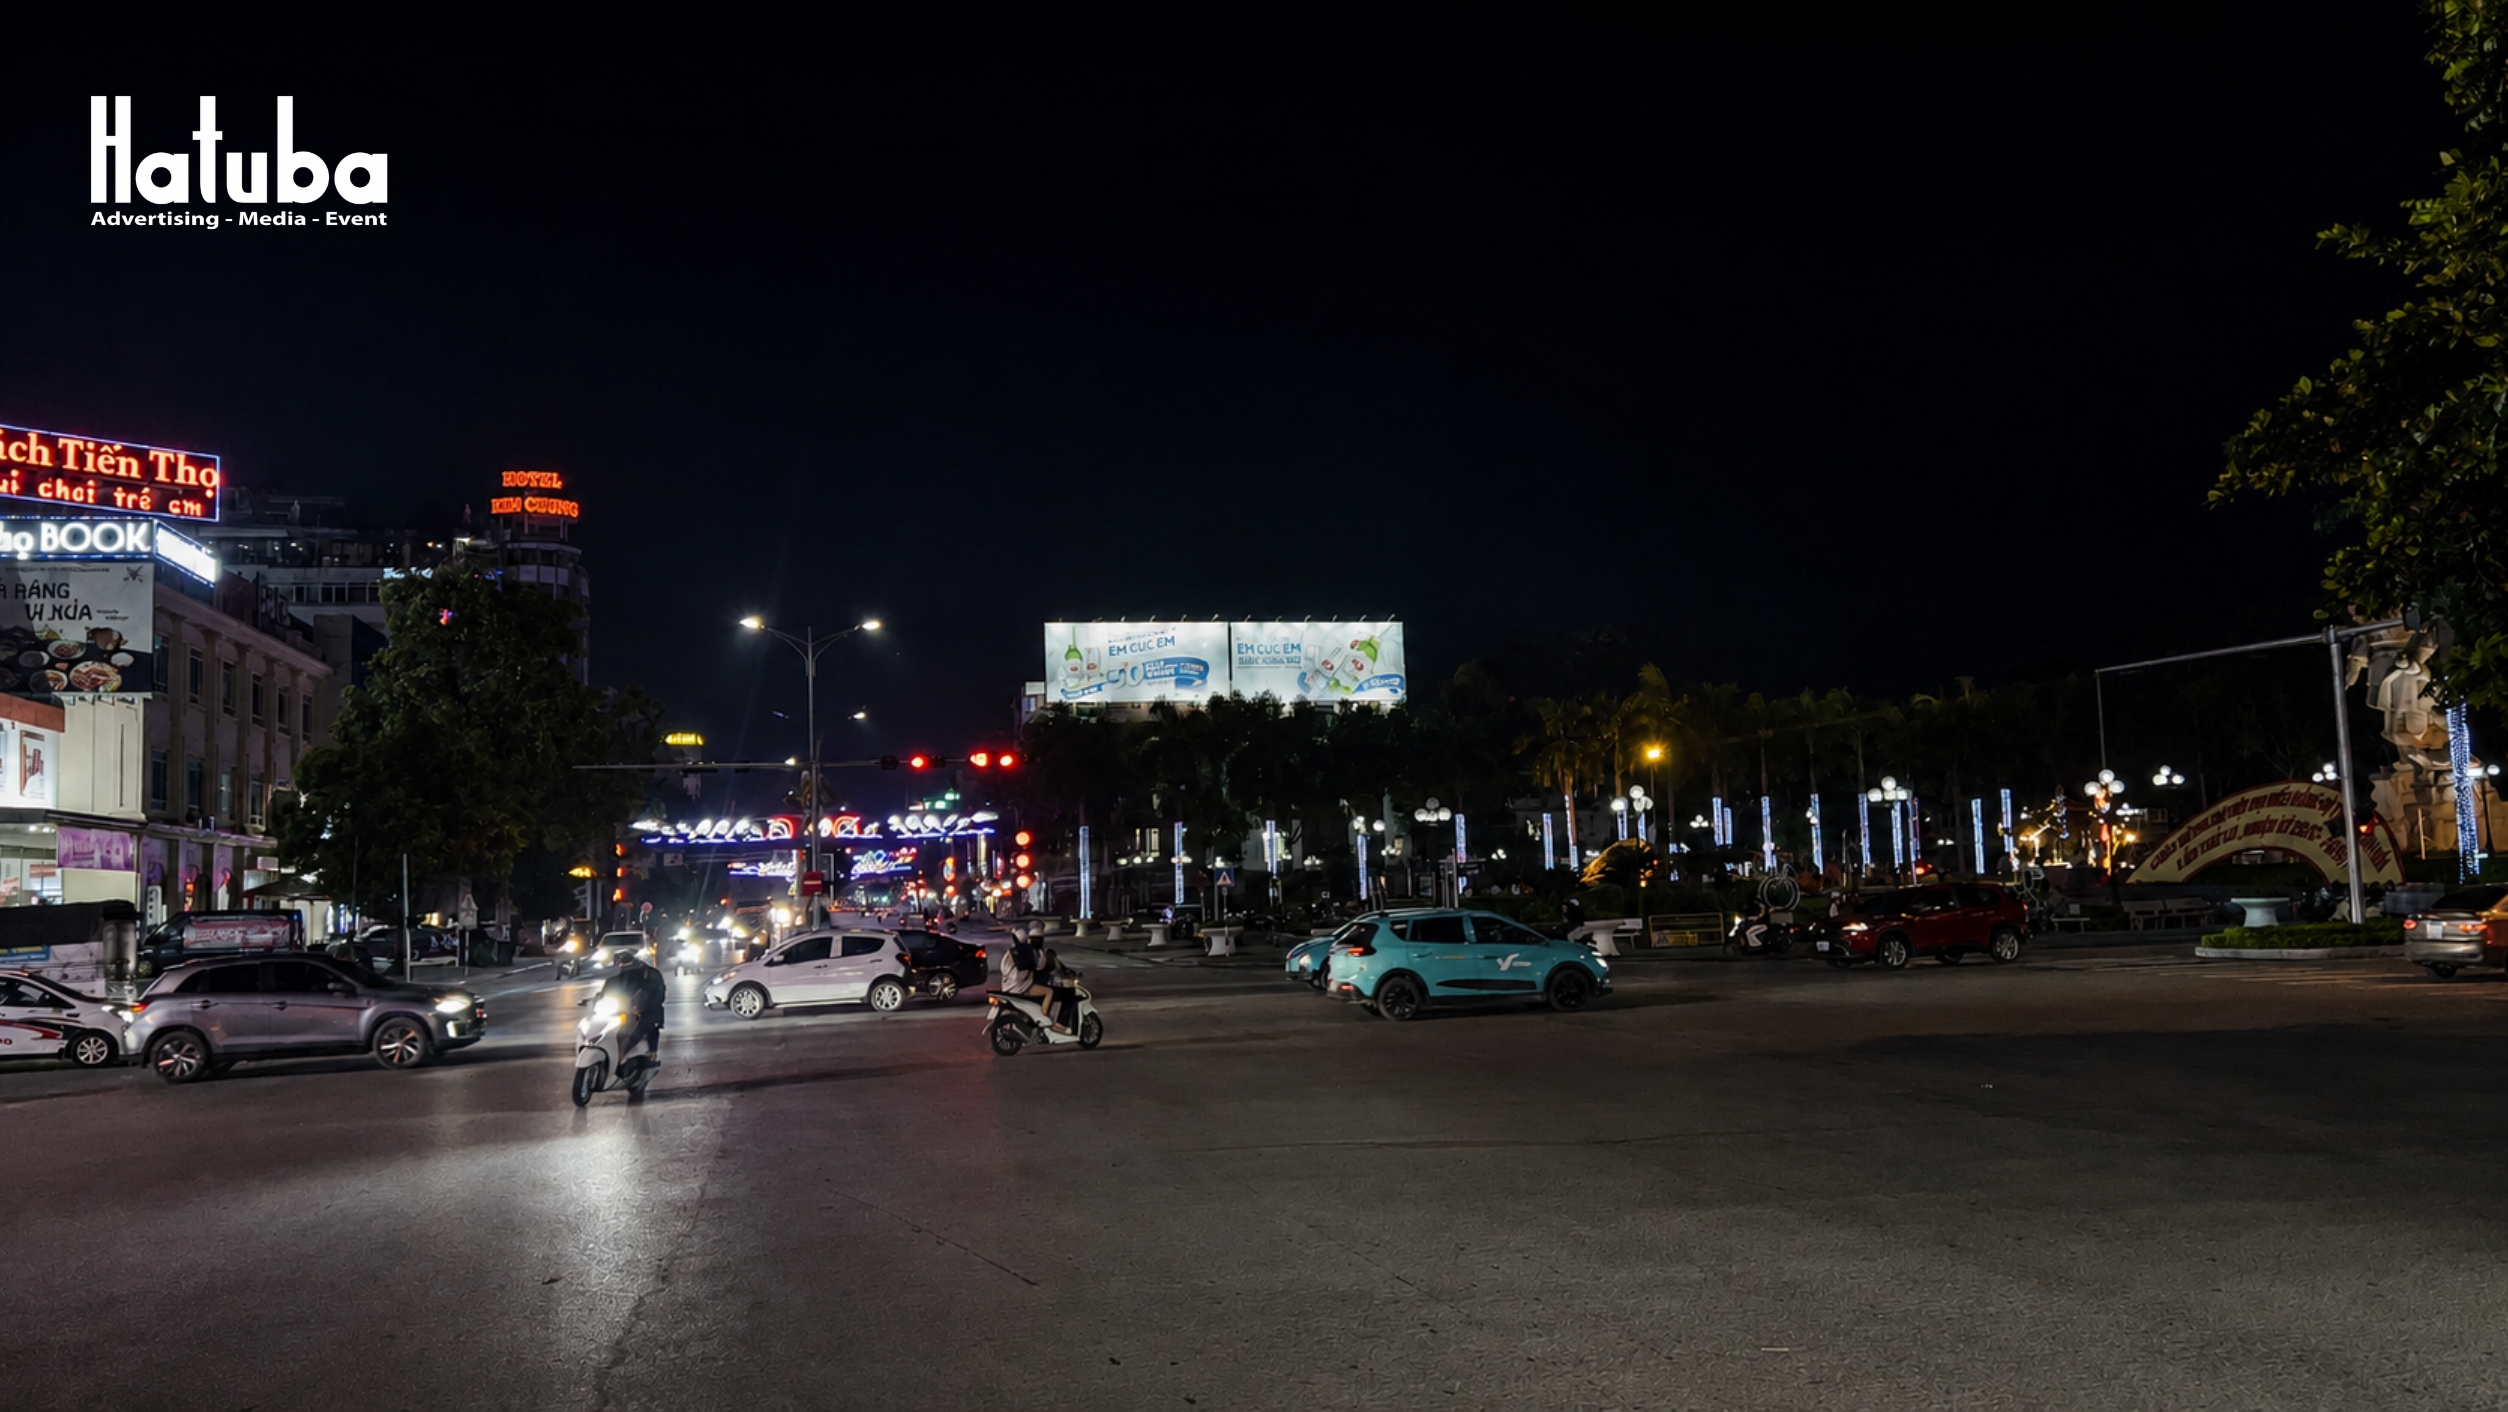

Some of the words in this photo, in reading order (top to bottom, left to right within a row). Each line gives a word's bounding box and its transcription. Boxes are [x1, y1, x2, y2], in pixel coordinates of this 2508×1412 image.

[58, 437, 141, 479] Tiến
[149, 450, 220, 498] Thọ
[41, 522, 151, 552] BOOK
